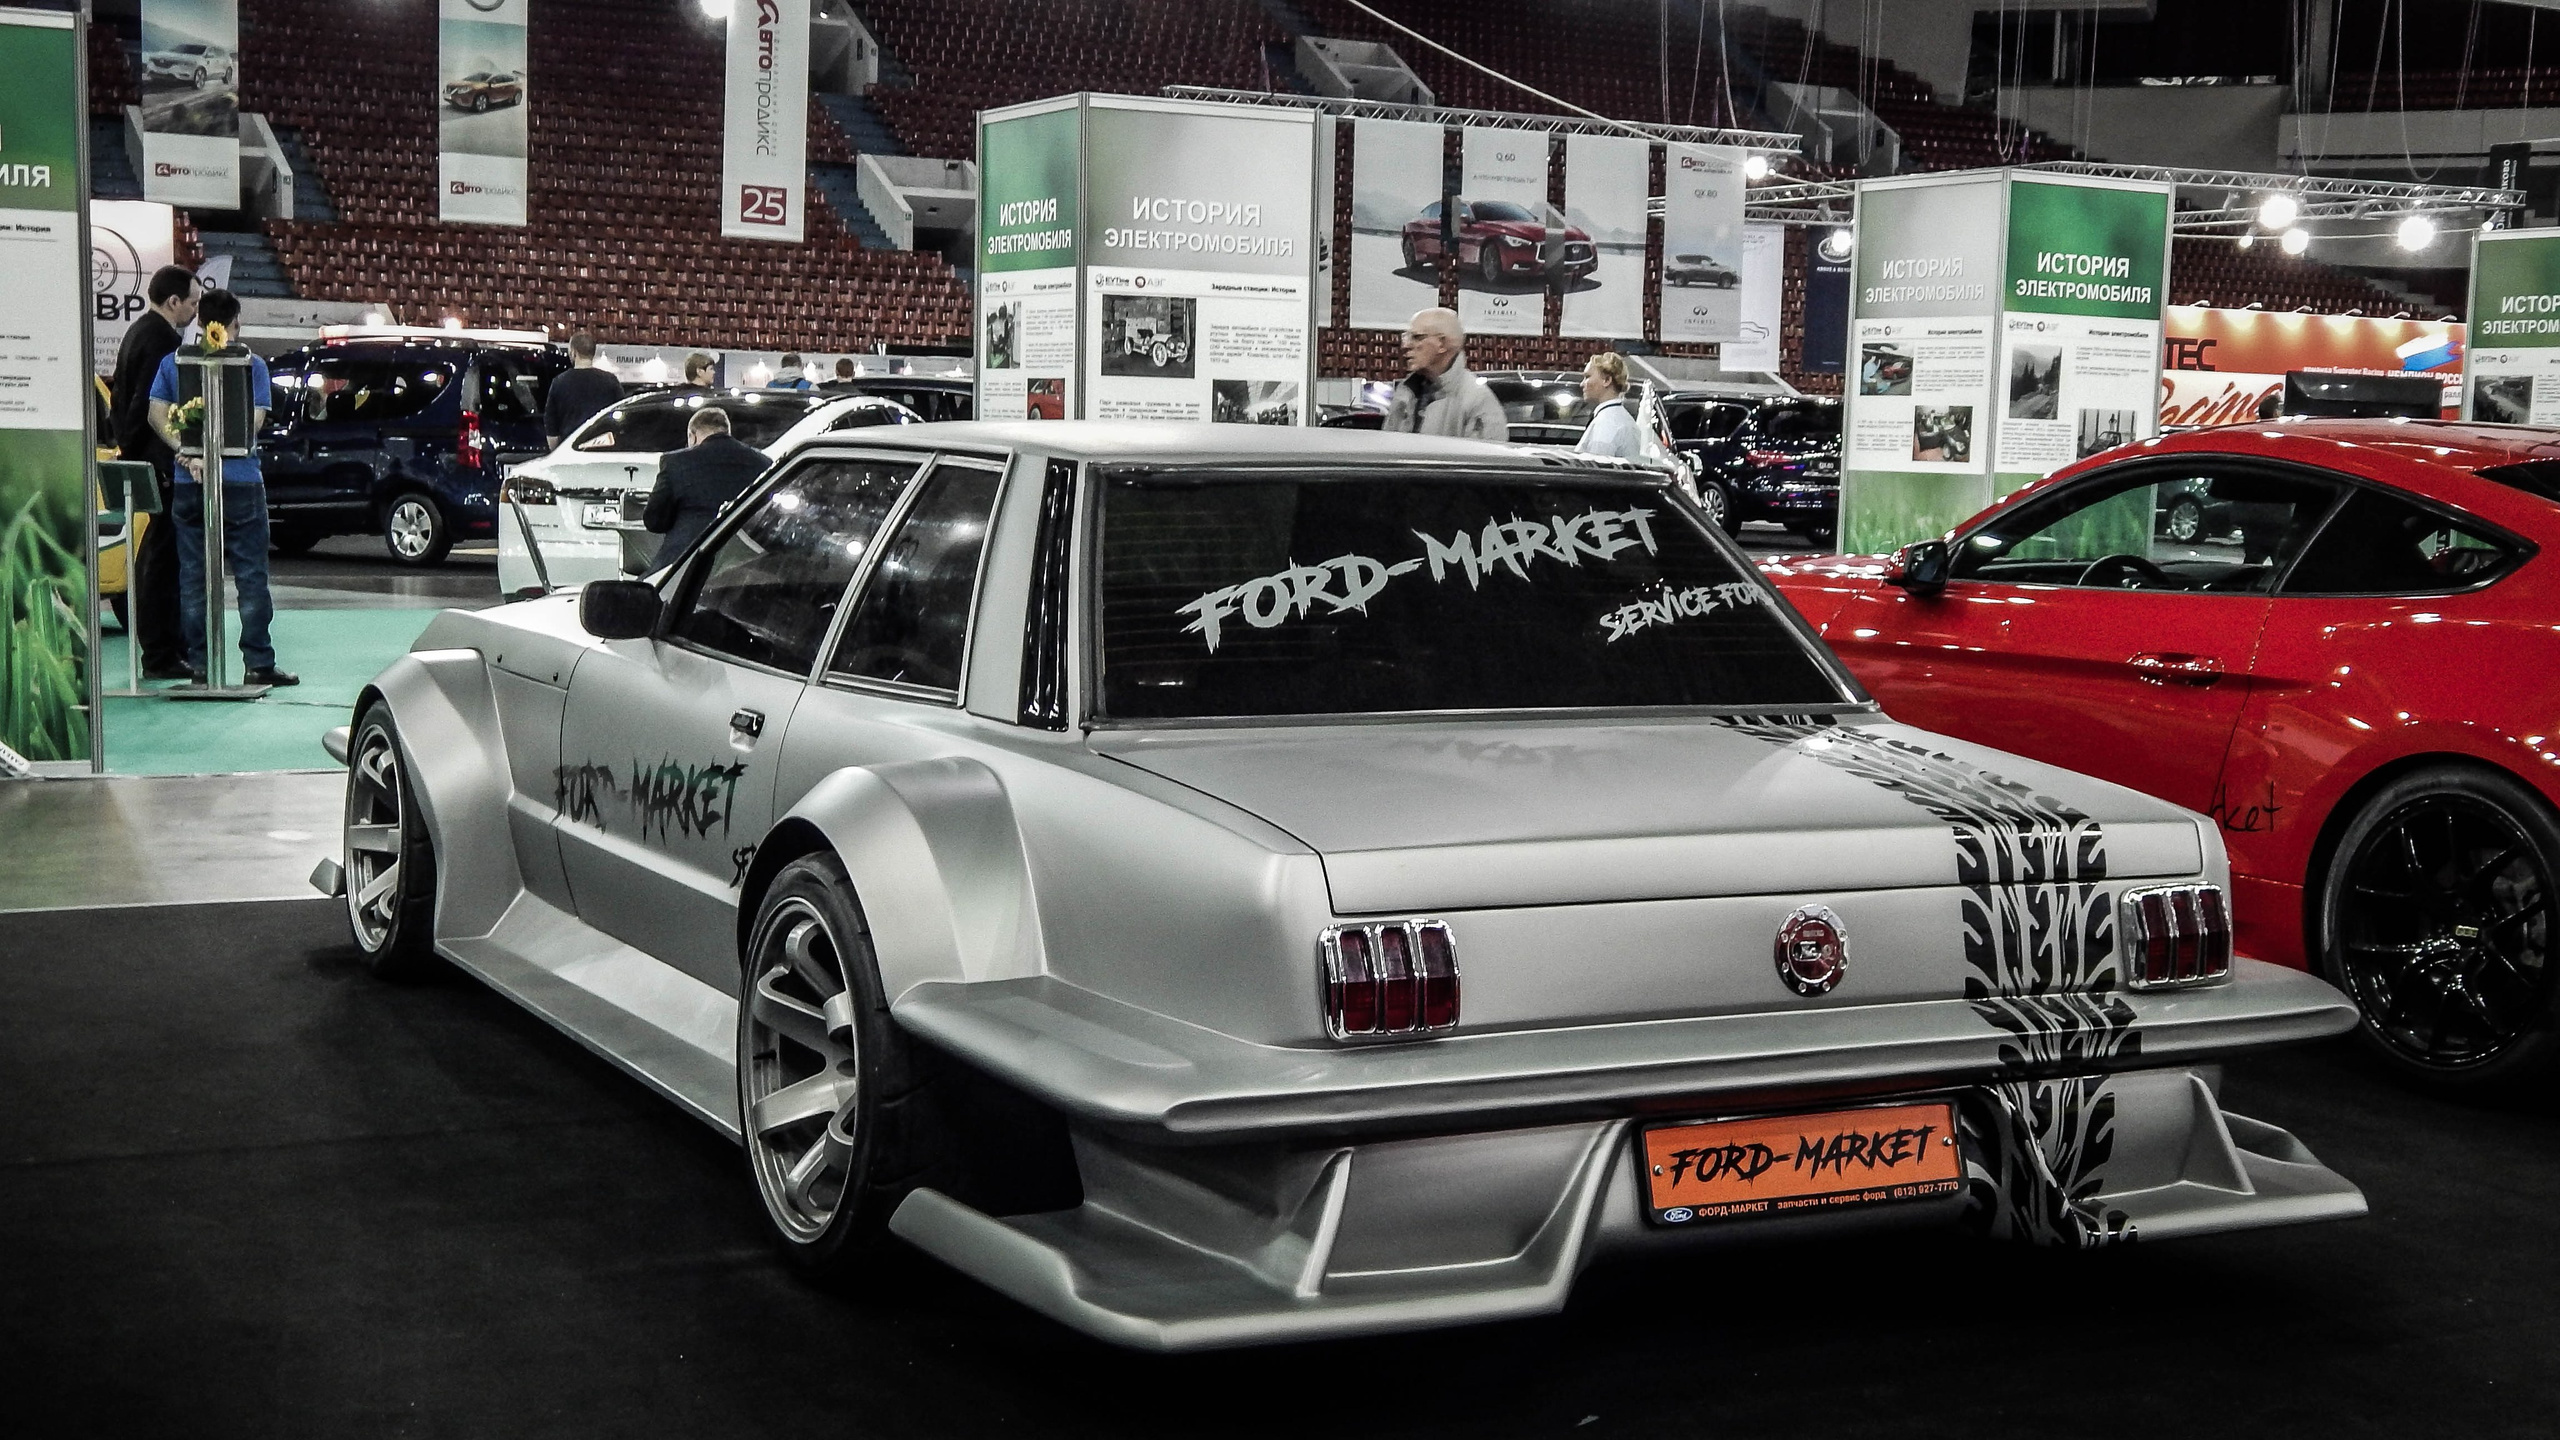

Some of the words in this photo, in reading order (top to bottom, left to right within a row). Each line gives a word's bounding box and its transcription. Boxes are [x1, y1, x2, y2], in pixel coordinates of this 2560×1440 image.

[742, 187, 785, 222] 25
[999, 197, 1058, 227] ИСТОРИЯ
[1132, 196, 1262, 227] ИСТОРИЯ
[987, 229, 1072, 255] ЭЛЕКТРОМОБИЛЯ
[1104, 228, 1294, 257] ЭЛЕКТРОМОБИЛЯ
[1883, 257, 1964, 280] ИСТОРИЯ
[2037, 251, 2130, 278] ИСТОРИЯ
[1865, 284, 1984, 304] ЭЛЕКТРОМОБИЛЯ
[2016, 279, 2151, 304] ЭЛЕКТРОМОБИЛЯ
[2501, 295, 2560, 314] ИСТОР
[2482, 319, 2560, 335] ЭЛЕКТРОМ
[1174, 504, 1658, 654] FORD-MARKET
[1599, 585, 1720, 643] SERVICE
[1669, 1124, 1938, 1190] FORD-MARKET
[1698, 1201, 1769, 1217] ФОРД-МАРКЕТ
[1777, 1197, 1819, 1210] запчасти
[1829, 1194, 1860, 1206] сервис
[1862, 1190, 1887, 1202] форд
[1894, 1186, 1917, 1199] (812)
